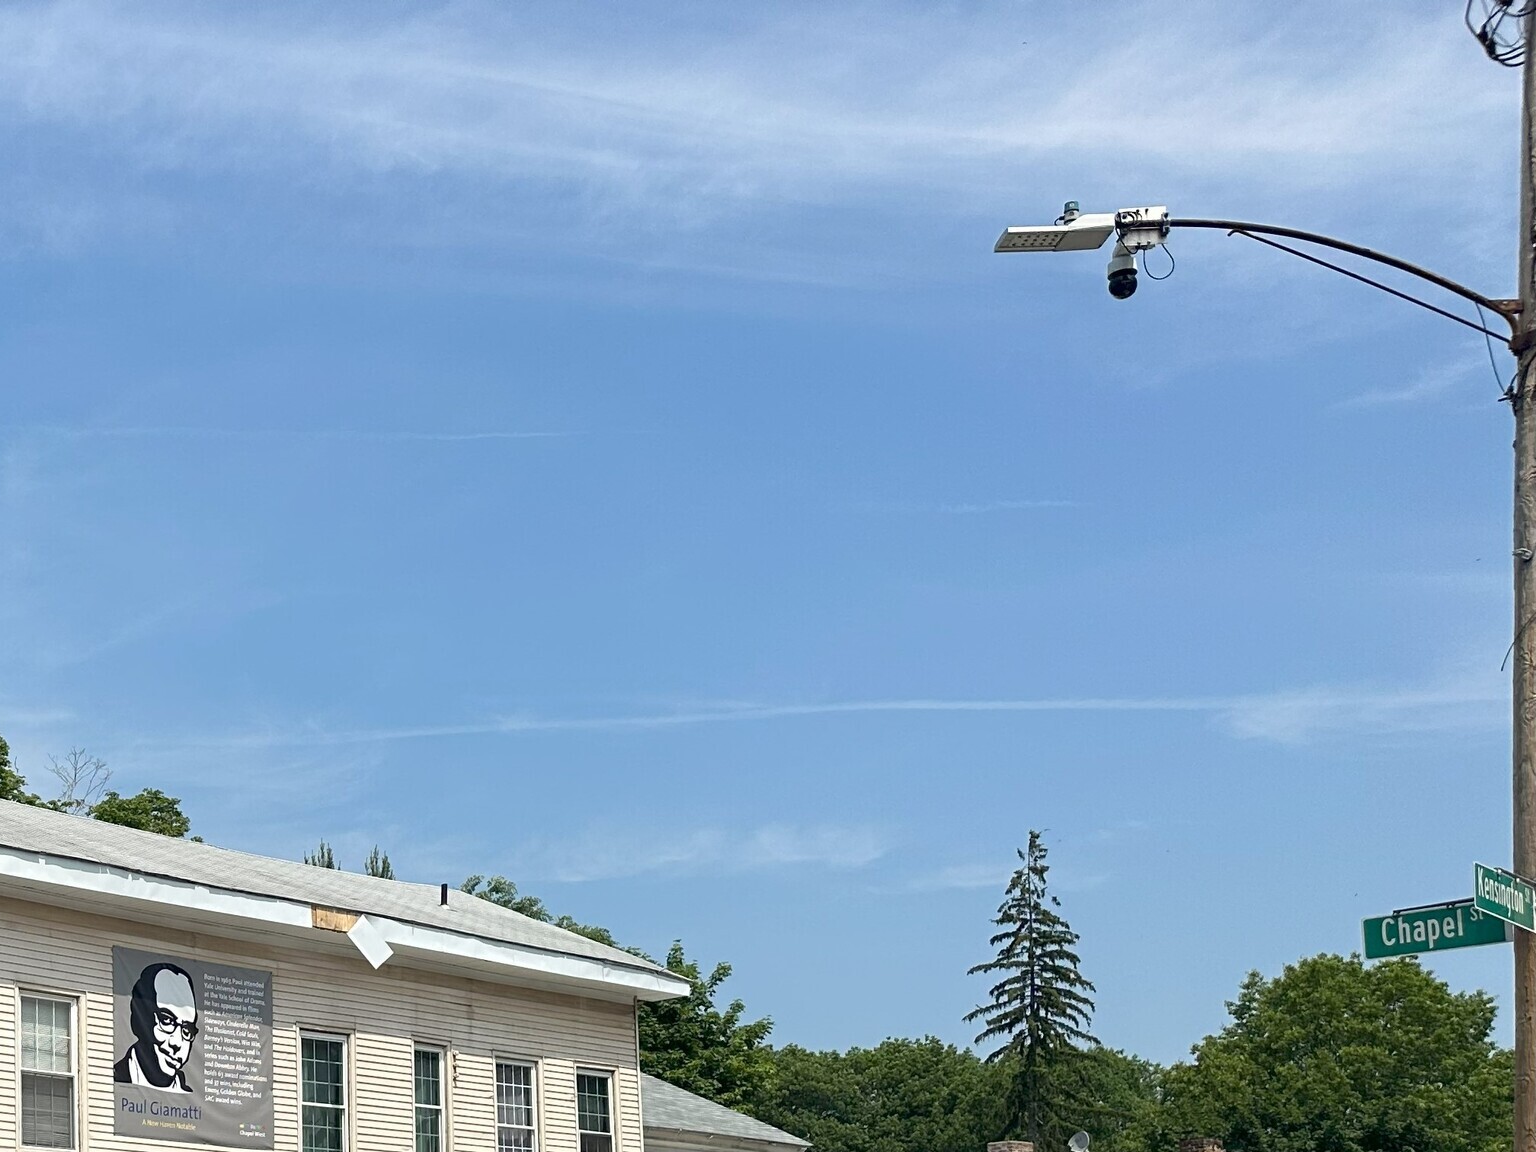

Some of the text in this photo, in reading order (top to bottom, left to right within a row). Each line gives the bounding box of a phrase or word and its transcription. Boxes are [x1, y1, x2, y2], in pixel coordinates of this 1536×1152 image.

[1477, 866, 1524, 917] Kensington
[1381, 907, 1484, 949] Chapel St
[215, 984, 237, 994] University
[229, 994, 243, 1002] School
[221, 1003, 241, 1011] appeared
[232, 1082, 253, 1090] including
[121, 1097, 202, 1120] Paul Giamatti
[177, 1122, 196, 1131] Notable
[240, 1129, 254, 1137] Chapel
